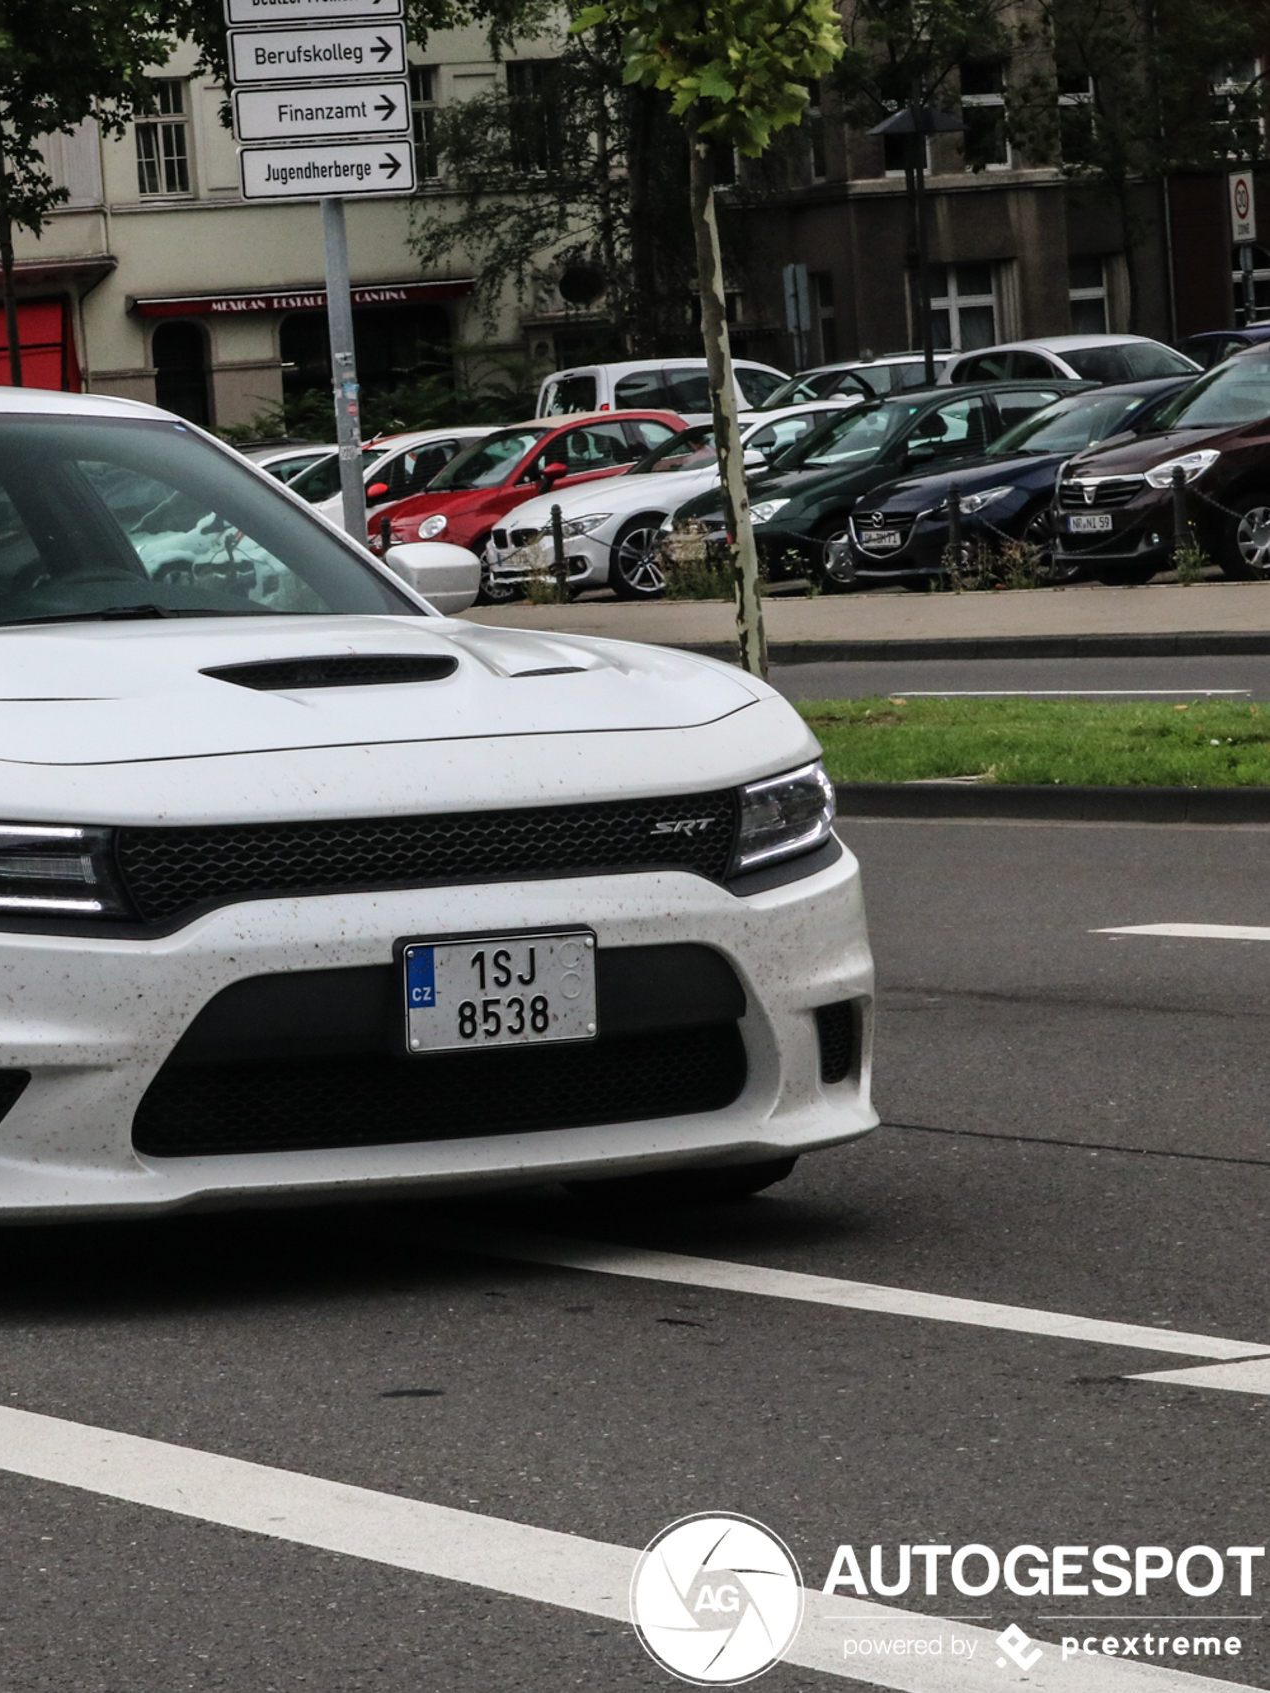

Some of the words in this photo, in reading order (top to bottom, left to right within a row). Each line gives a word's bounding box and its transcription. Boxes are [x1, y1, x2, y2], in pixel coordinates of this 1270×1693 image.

[254, 43, 363, 65] Berufskolleg
[278, 101, 367, 123] Finanzamt
[264, 160, 372, 185] Jugendherberge
[211, 299, 266, 312] MEXICAN
[273, 295, 327, 309] RESTAUR
[354, 290, 407, 303] CANTINA
[650, 817, 716, 837] SRT
[470, 946, 536, 990] 1SJ
[412, 987, 432, 1002] CZ
[458, 993, 550, 1040] 8538
